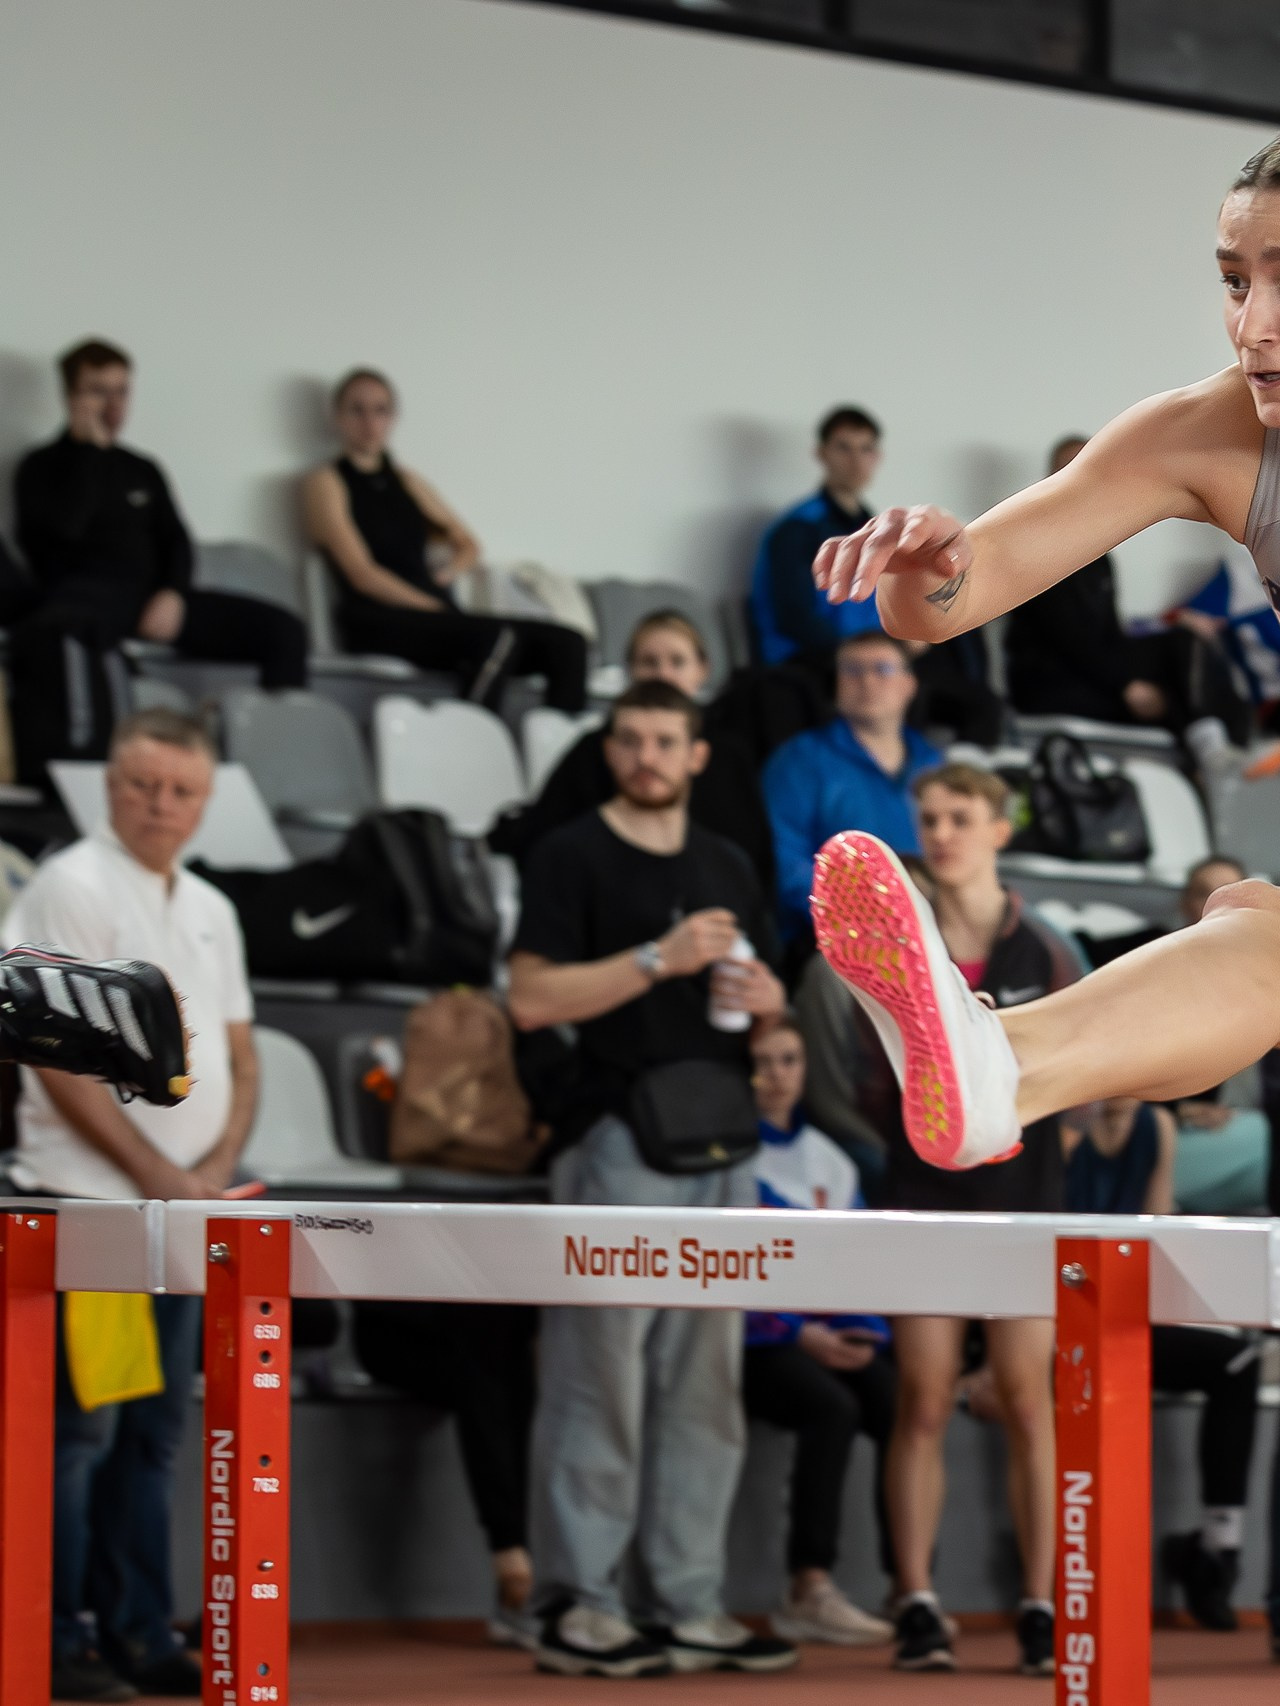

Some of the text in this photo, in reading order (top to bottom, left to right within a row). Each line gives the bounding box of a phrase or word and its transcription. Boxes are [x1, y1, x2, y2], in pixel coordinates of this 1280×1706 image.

[564, 1235, 769, 1289] Nordic Sport
[252, 1476, 280, 1493] 762
[206, 1429, 236, 1685] Nordic Sport
[1062, 1470, 1095, 1621] Nordic
[250, 1685, 279, 1702] 914
